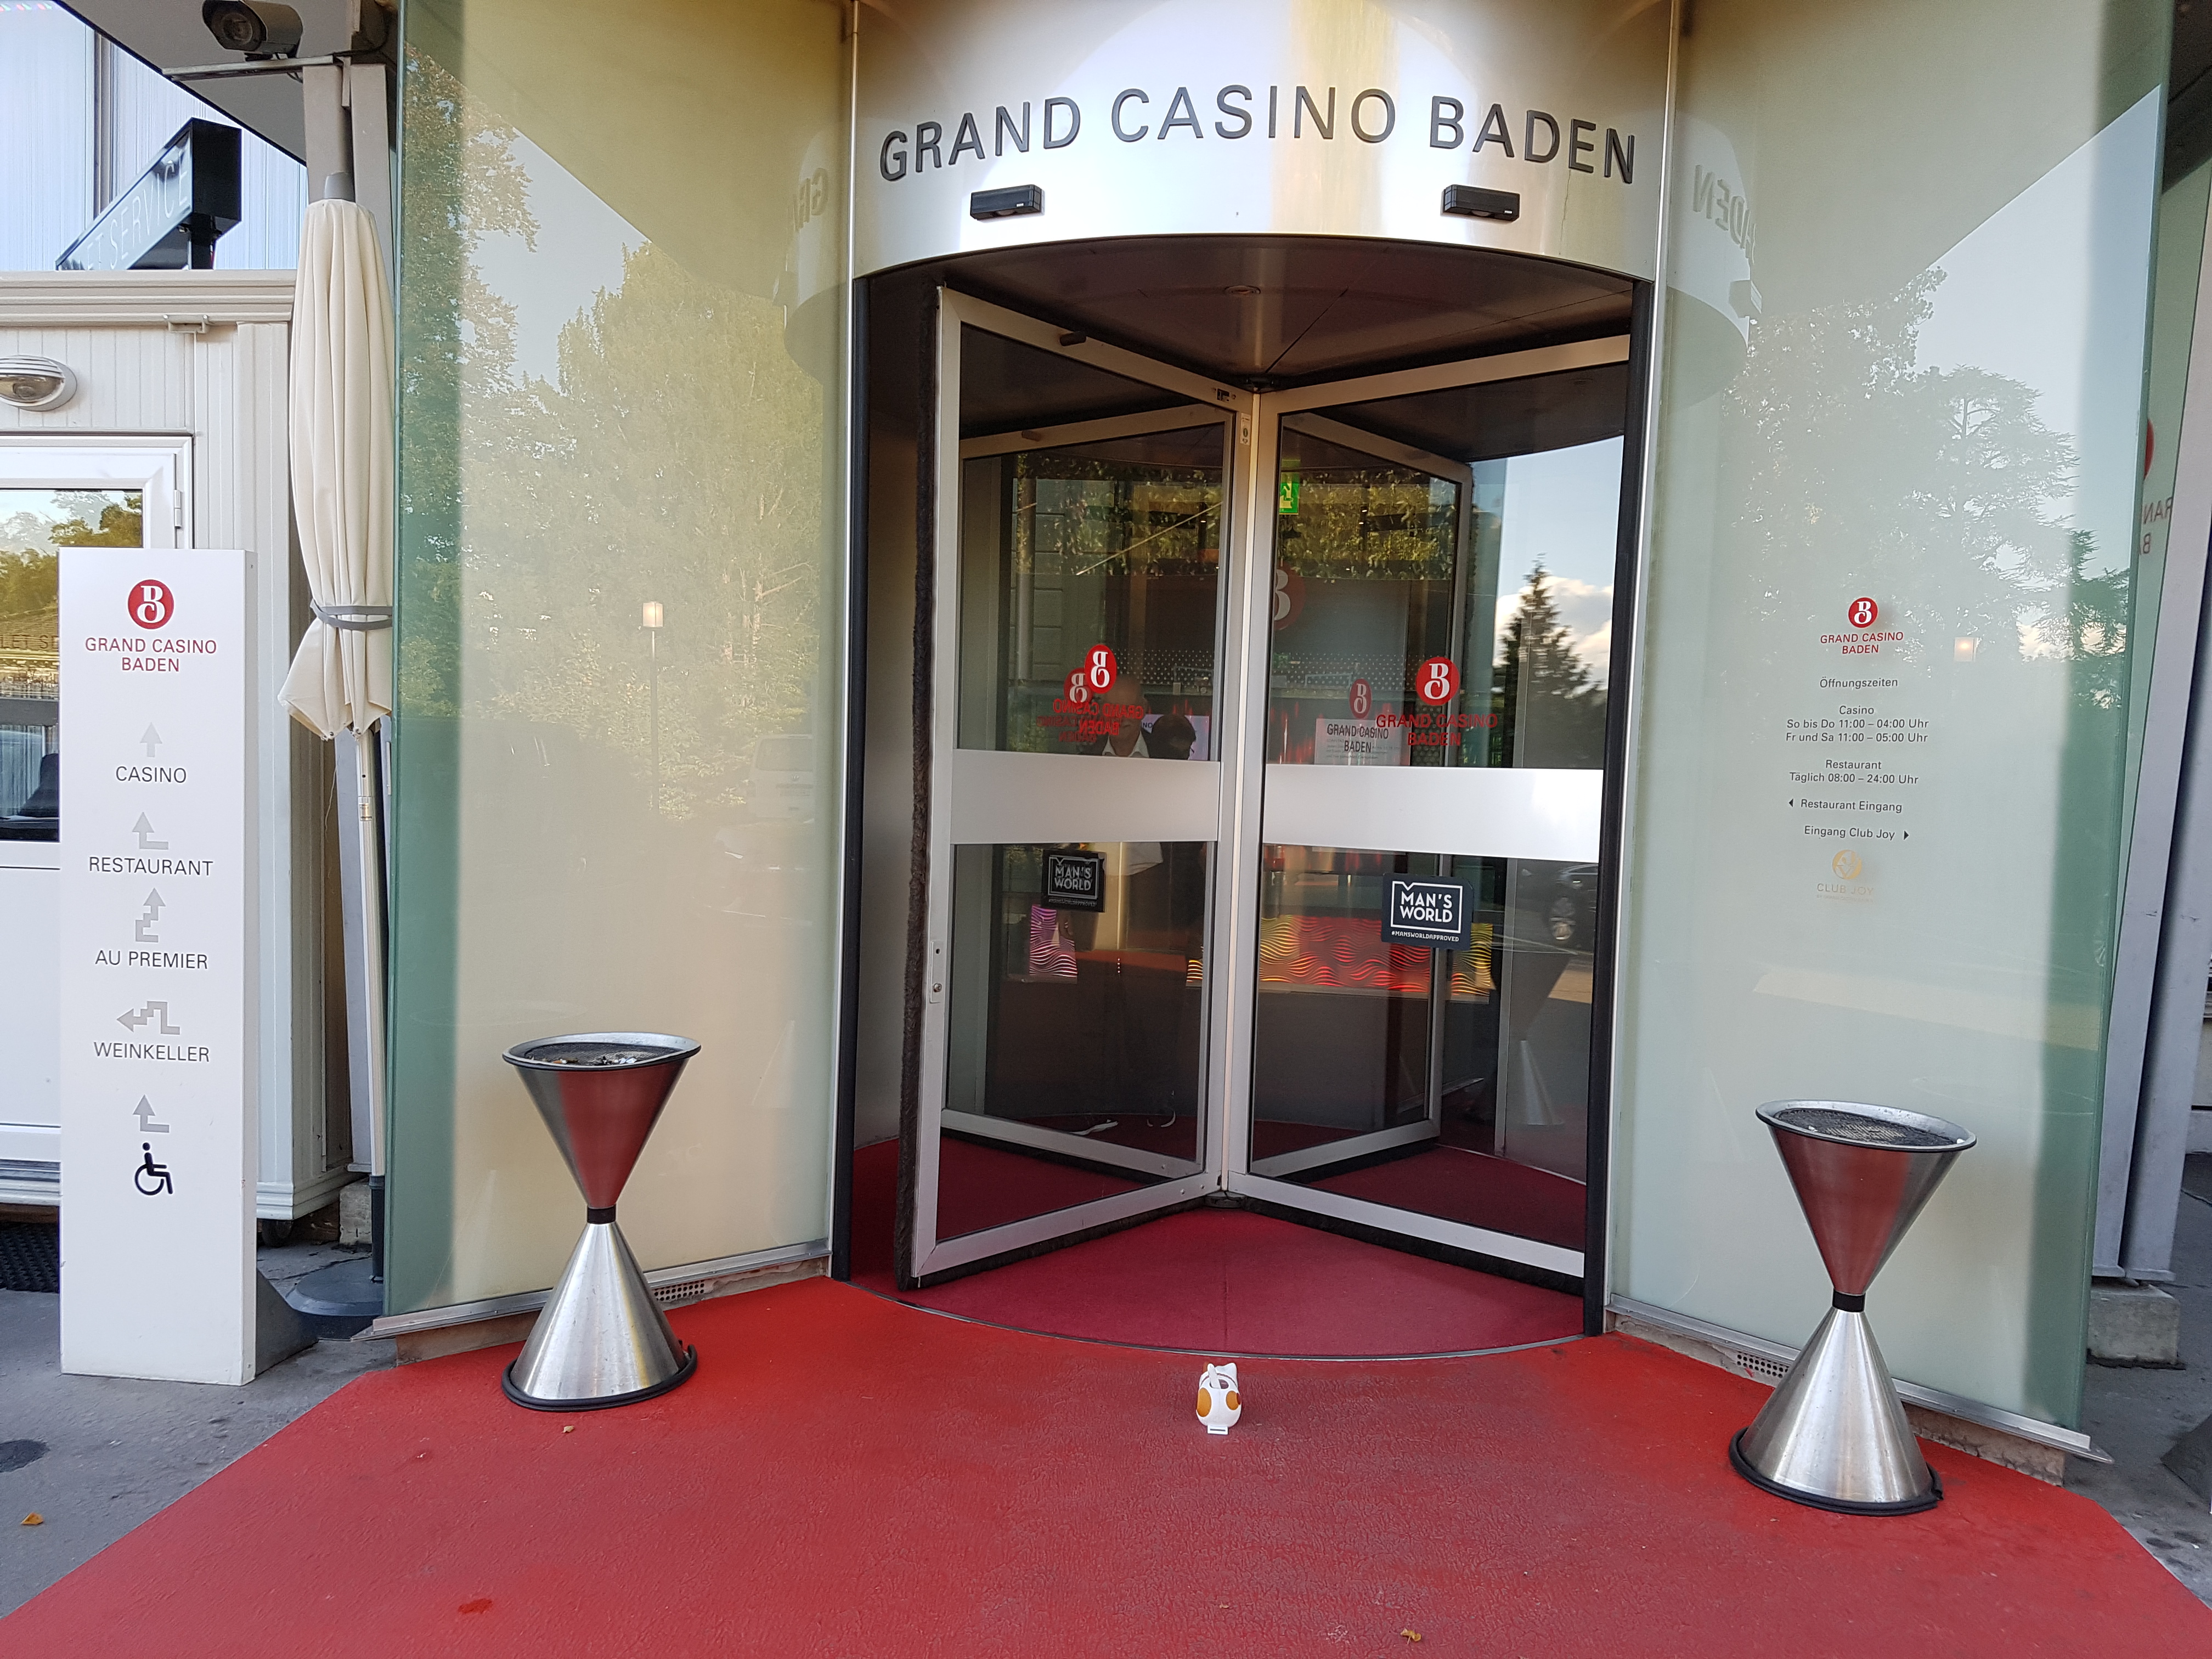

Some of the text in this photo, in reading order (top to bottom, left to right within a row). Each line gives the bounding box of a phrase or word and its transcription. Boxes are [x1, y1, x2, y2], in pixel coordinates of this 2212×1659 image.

[879, 84, 1634, 184] GRAND CASINO BADEN
[110, 150, 187, 269] SERVICE
[86, 637, 217, 653] GRAND CASINO
[1820, 632, 1904, 644] GRAND CASINO
[1842, 645, 1878, 654] BADEN
[122, 658, 179, 672] BADEN
[1820, 676, 1898, 689] Öffnungszeiten
[1839, 706, 1874, 715] Casino
[1376, 713, 1498, 728] GRAND CASINO
[1787, 719, 1800, 728] So
[1803, 719, 1818, 728] bis
[1821, 719, 1835, 728] Do
[1840, 719, 1865, 728] 11:00
[1877, 719, 1905, 728] 04:00
[1909, 719, 1929, 728] Uhr
[1327, 724, 1389, 739] GRAND CASINO
[1786, 733, 1796, 741] Fr
[1799, 733, 1818, 742] und
[1821, 733, 1834, 742] Sa
[1839, 733, 1864, 742] 11:00
[1876, 733, 1904, 742] 05:00
[1908, 733, 1928, 742] Uhr
[1408, 732, 1460, 746] BADEN
[1345, 741, 1371, 753] BADEN
[1826, 760, 1881, 769] Restaurant
[116, 766, 187, 783] CASINO
[1790, 772, 1825, 783] Täglich
[1828, 774, 1855, 782] 08:00
[1867, 775, 1895, 783] 24:00
[1899, 775, 1918, 784] Uhr
[1801, 799, 1902, 813] Restaurant Eingang
[1805, 826, 1895, 840] Eingang Club Joy
[89, 857, 213, 876] RESTAURANT
[1054, 877, 1091, 891] WORLD
[1817, 883, 1846, 894] CLUB
[1401, 891, 1452, 909] MAN'S
[1400, 906, 1453, 922] WORLD
[1392, 931, 1459, 941] #MANSWORLDAPPROVED
[95, 950, 207, 969] AU PREMIER
[94, 1042, 210, 1062] WEINKELLER
